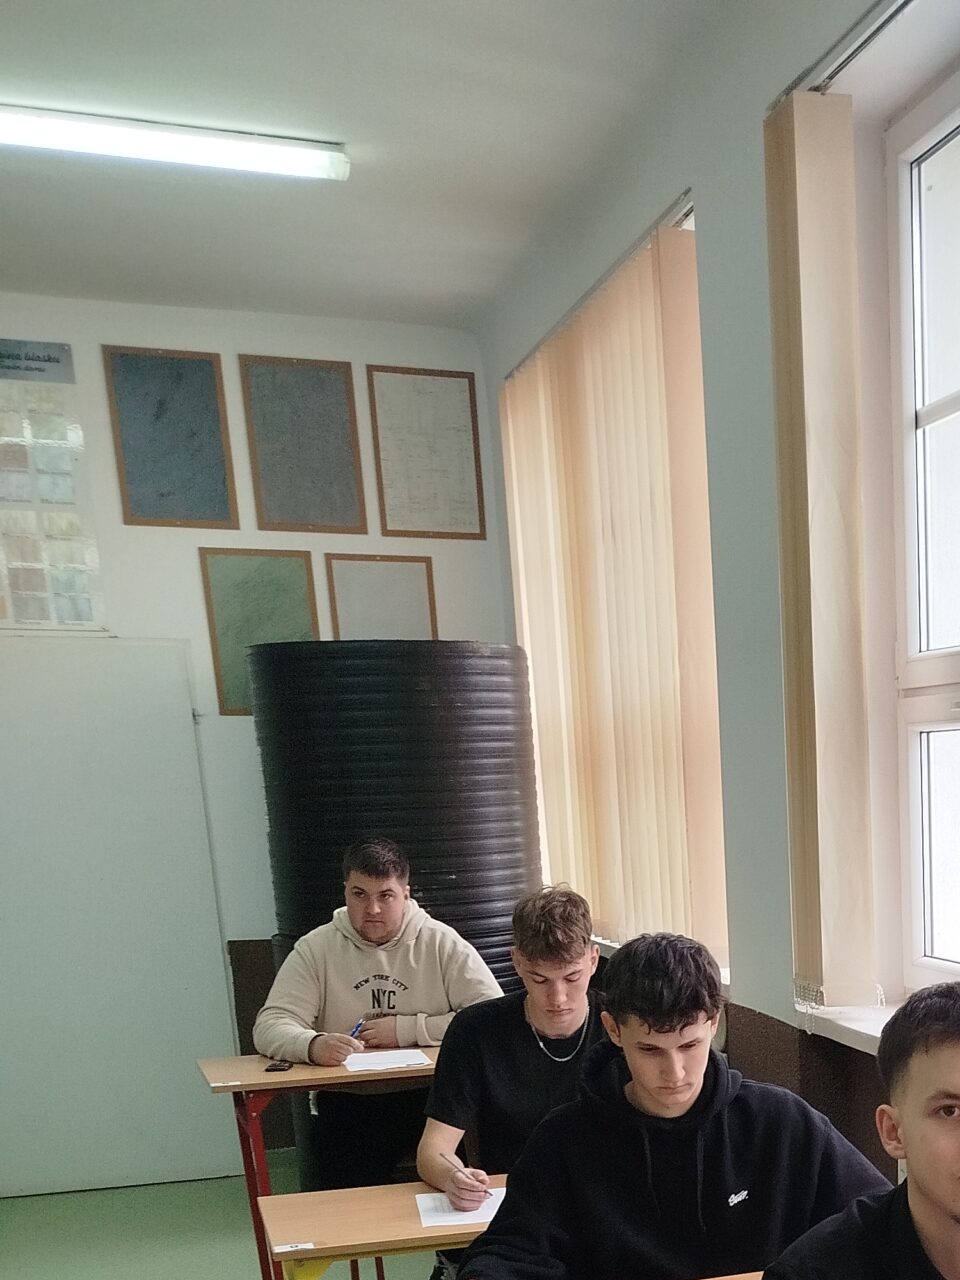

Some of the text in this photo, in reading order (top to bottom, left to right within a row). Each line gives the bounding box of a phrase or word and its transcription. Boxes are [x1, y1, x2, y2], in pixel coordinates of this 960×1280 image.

[353, 977, 370, 991] NEW
[392, 978, 409, 991] CITY
[371, 988, 396, 1009] NYC
